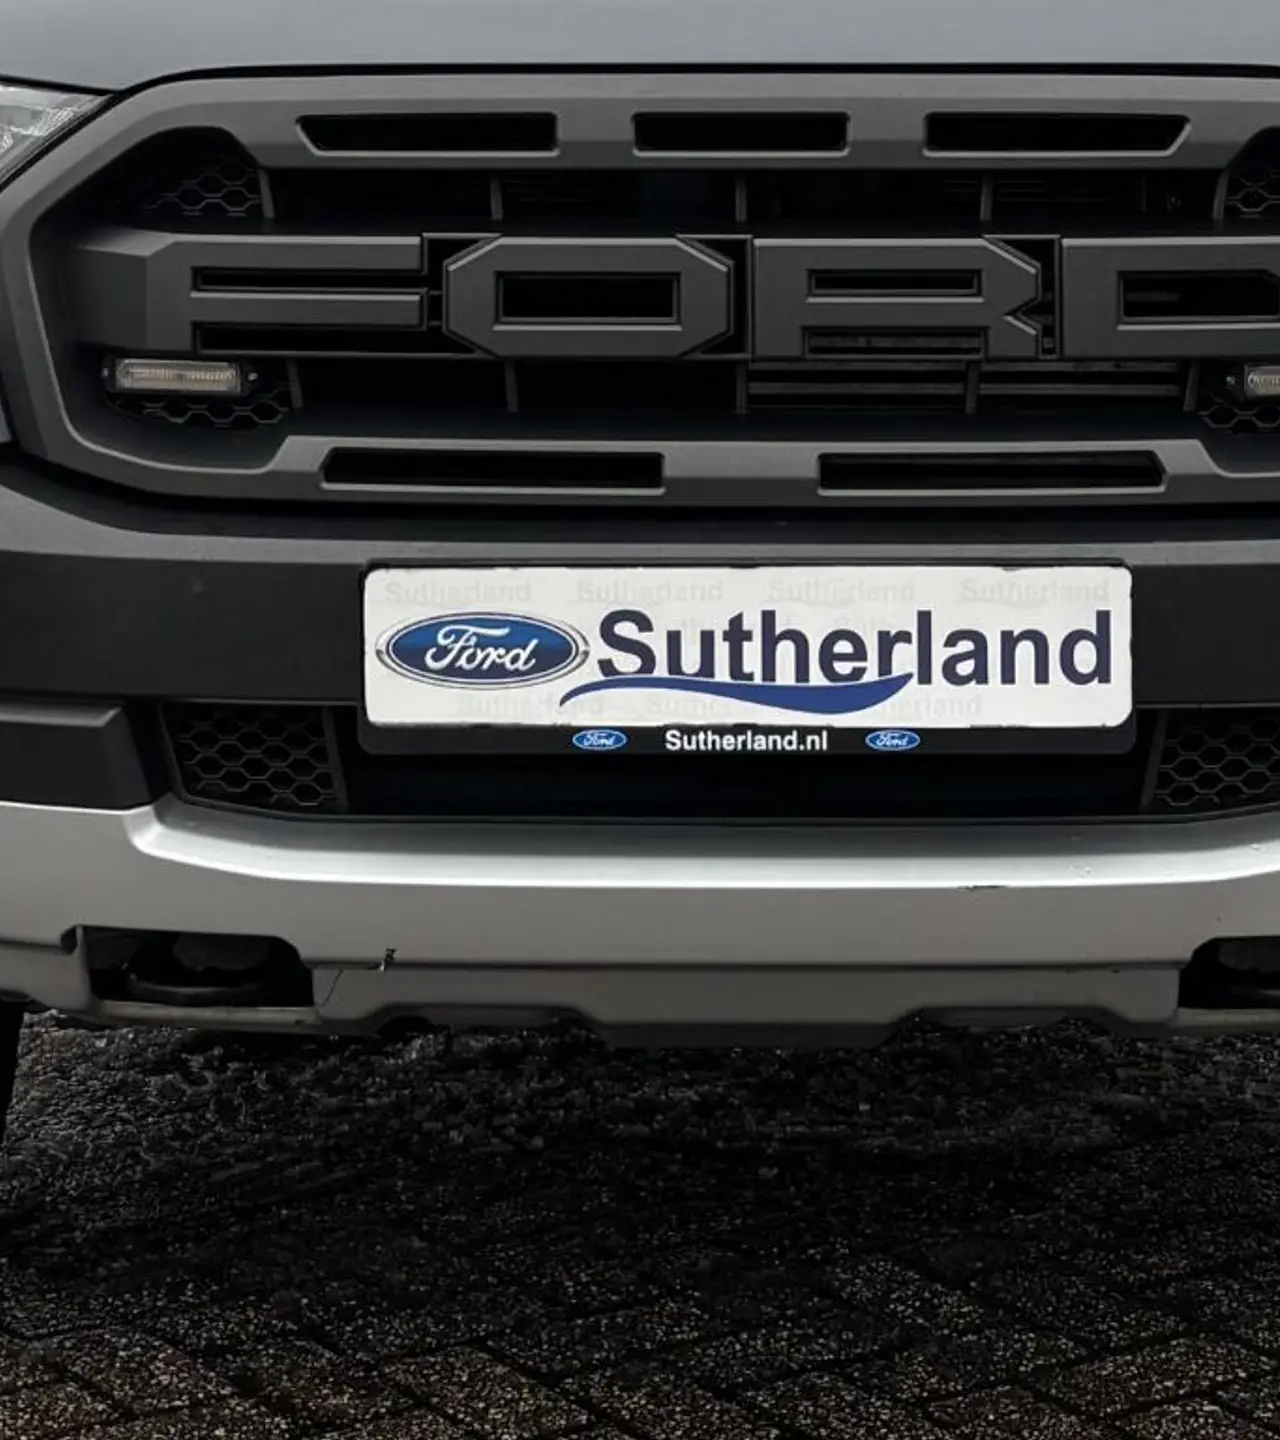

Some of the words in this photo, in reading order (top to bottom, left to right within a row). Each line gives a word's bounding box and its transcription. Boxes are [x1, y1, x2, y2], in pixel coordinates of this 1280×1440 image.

[425, 624, 540, 672] Ford
[597, 609, 1112, 686] Sutherland
[664, 729, 828, 752] Sutherland.nl
